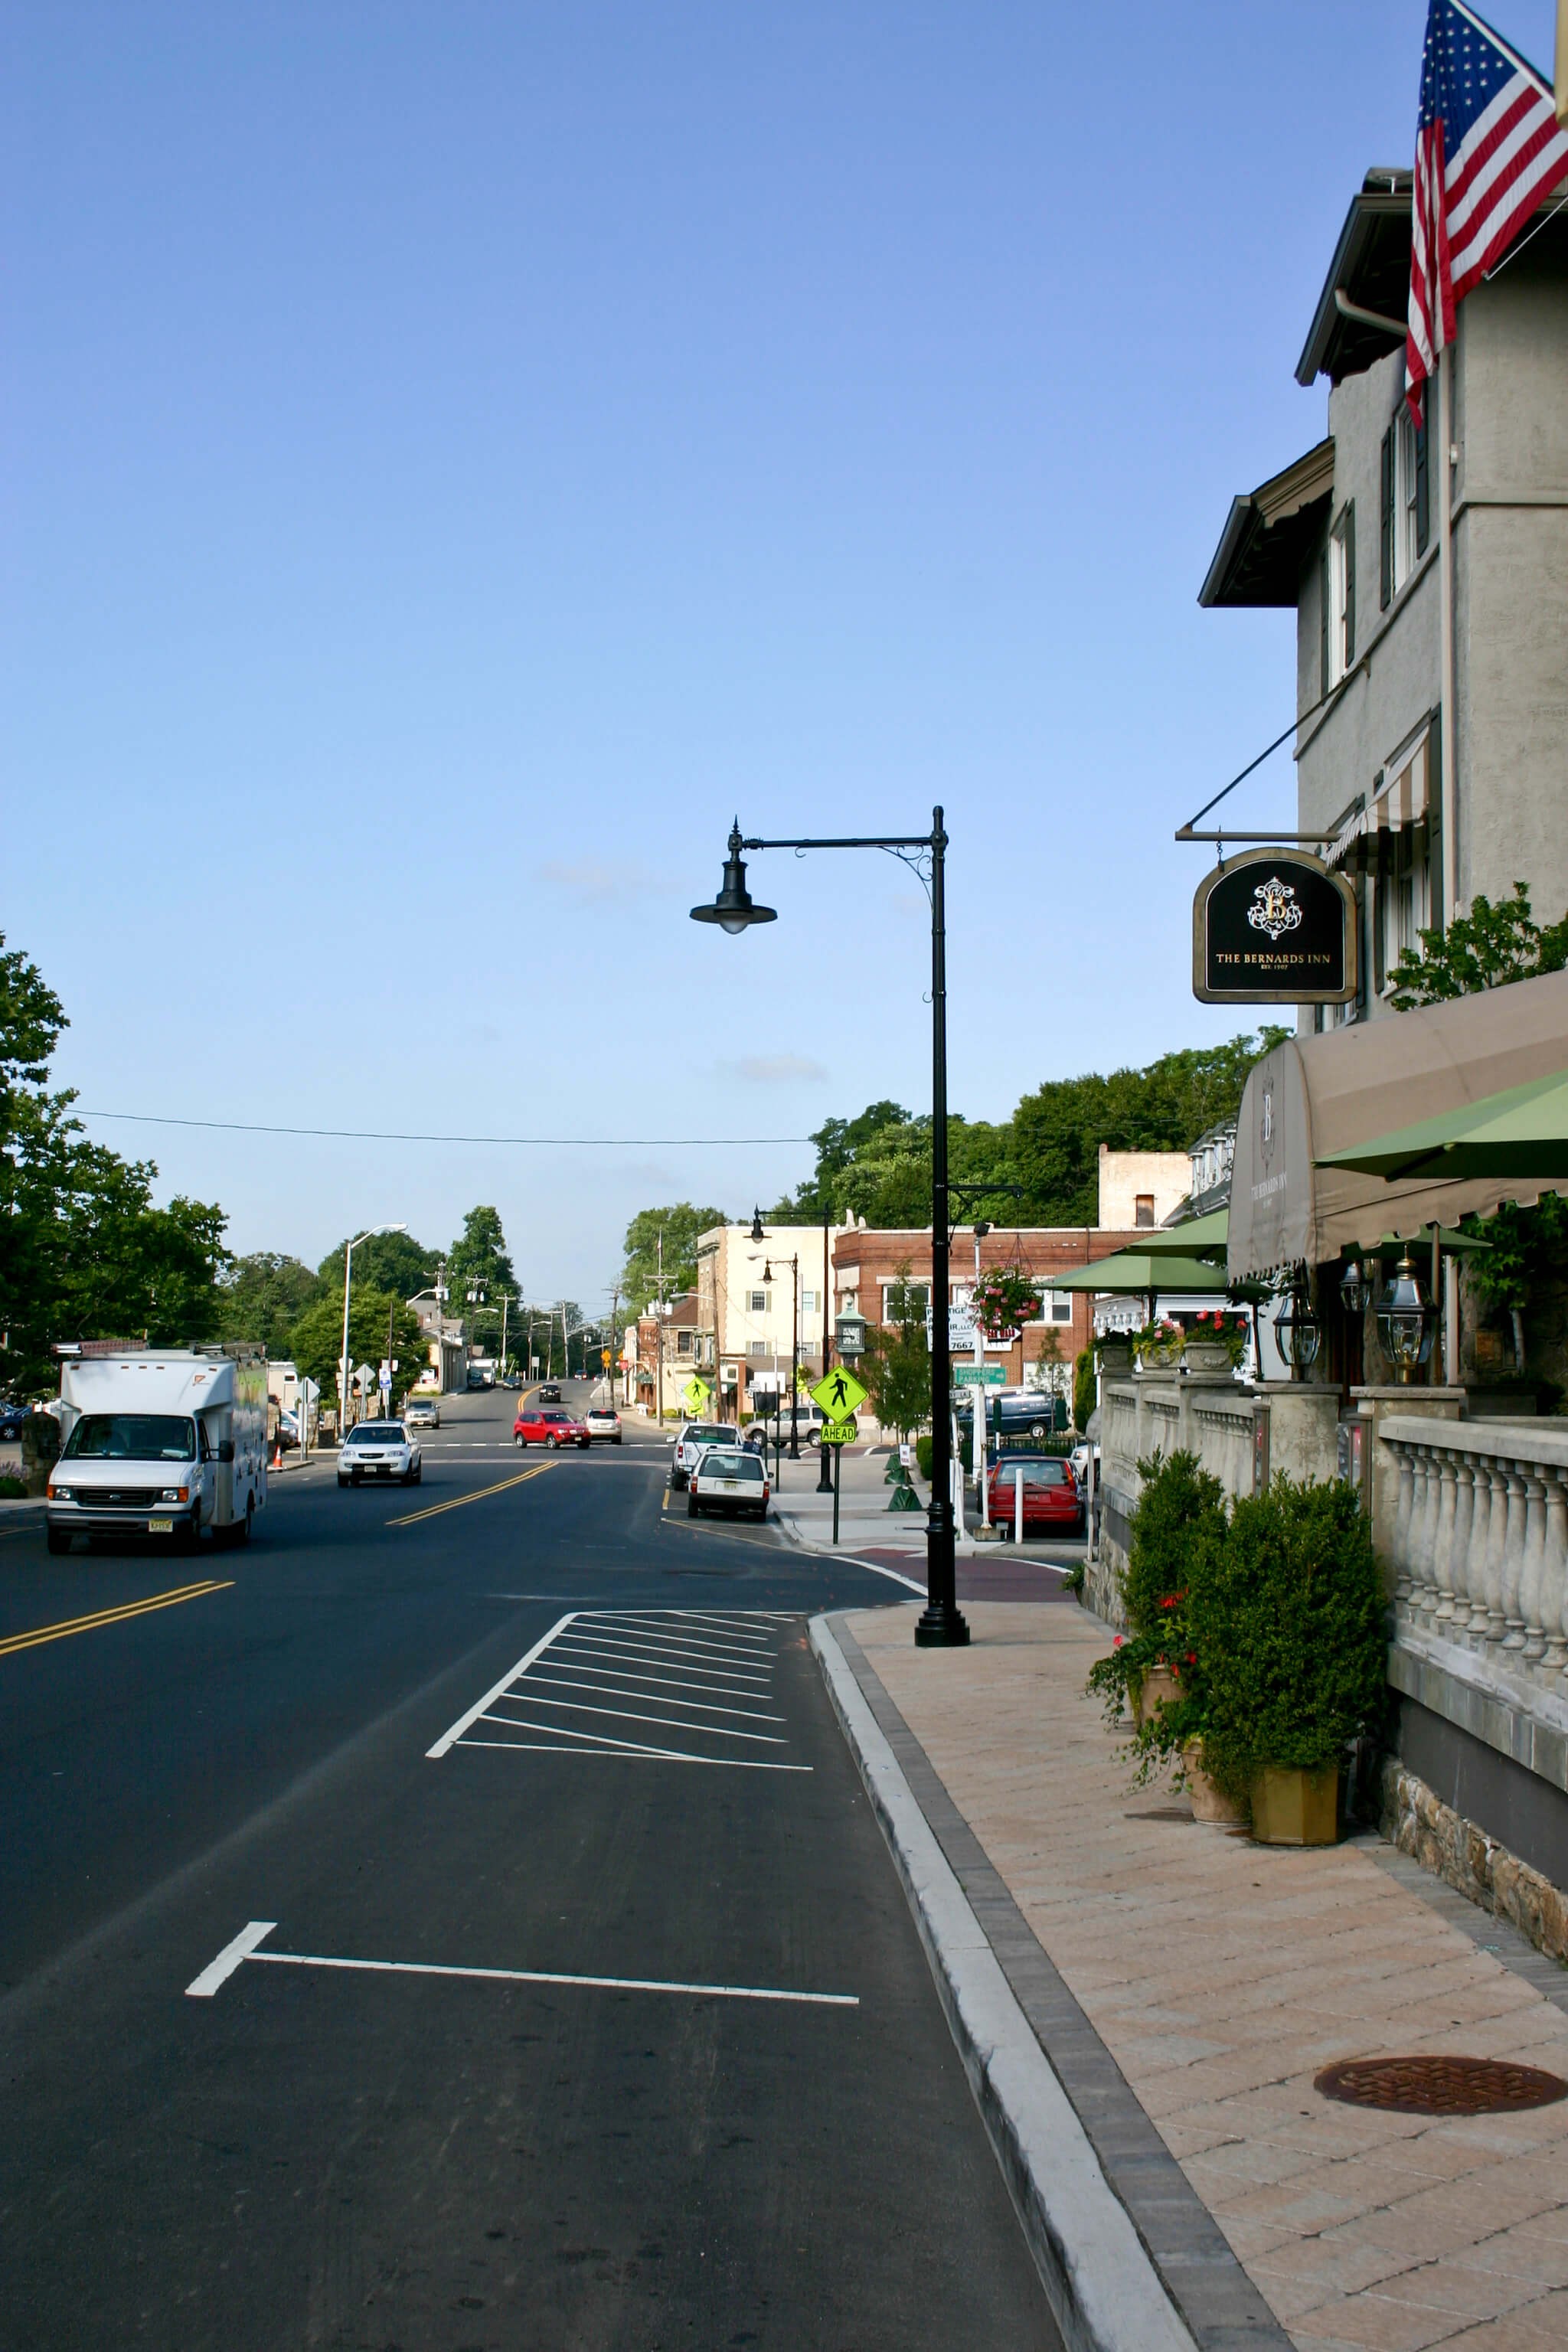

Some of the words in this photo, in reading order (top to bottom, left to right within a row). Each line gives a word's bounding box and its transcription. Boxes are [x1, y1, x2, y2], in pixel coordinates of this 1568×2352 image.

[1216, 953, 1240, 963] THE
[1244, 954, 1304, 964] BERNARDS
[1308, 954, 1331, 963] INN
[1265, 1094, 1272, 1142] B
[1259, 1175, 1279, 1199] BERNARDS
[959, 1367, 995, 1376] SHOPPERS
[823, 1427, 854, 1440] AHEAD
